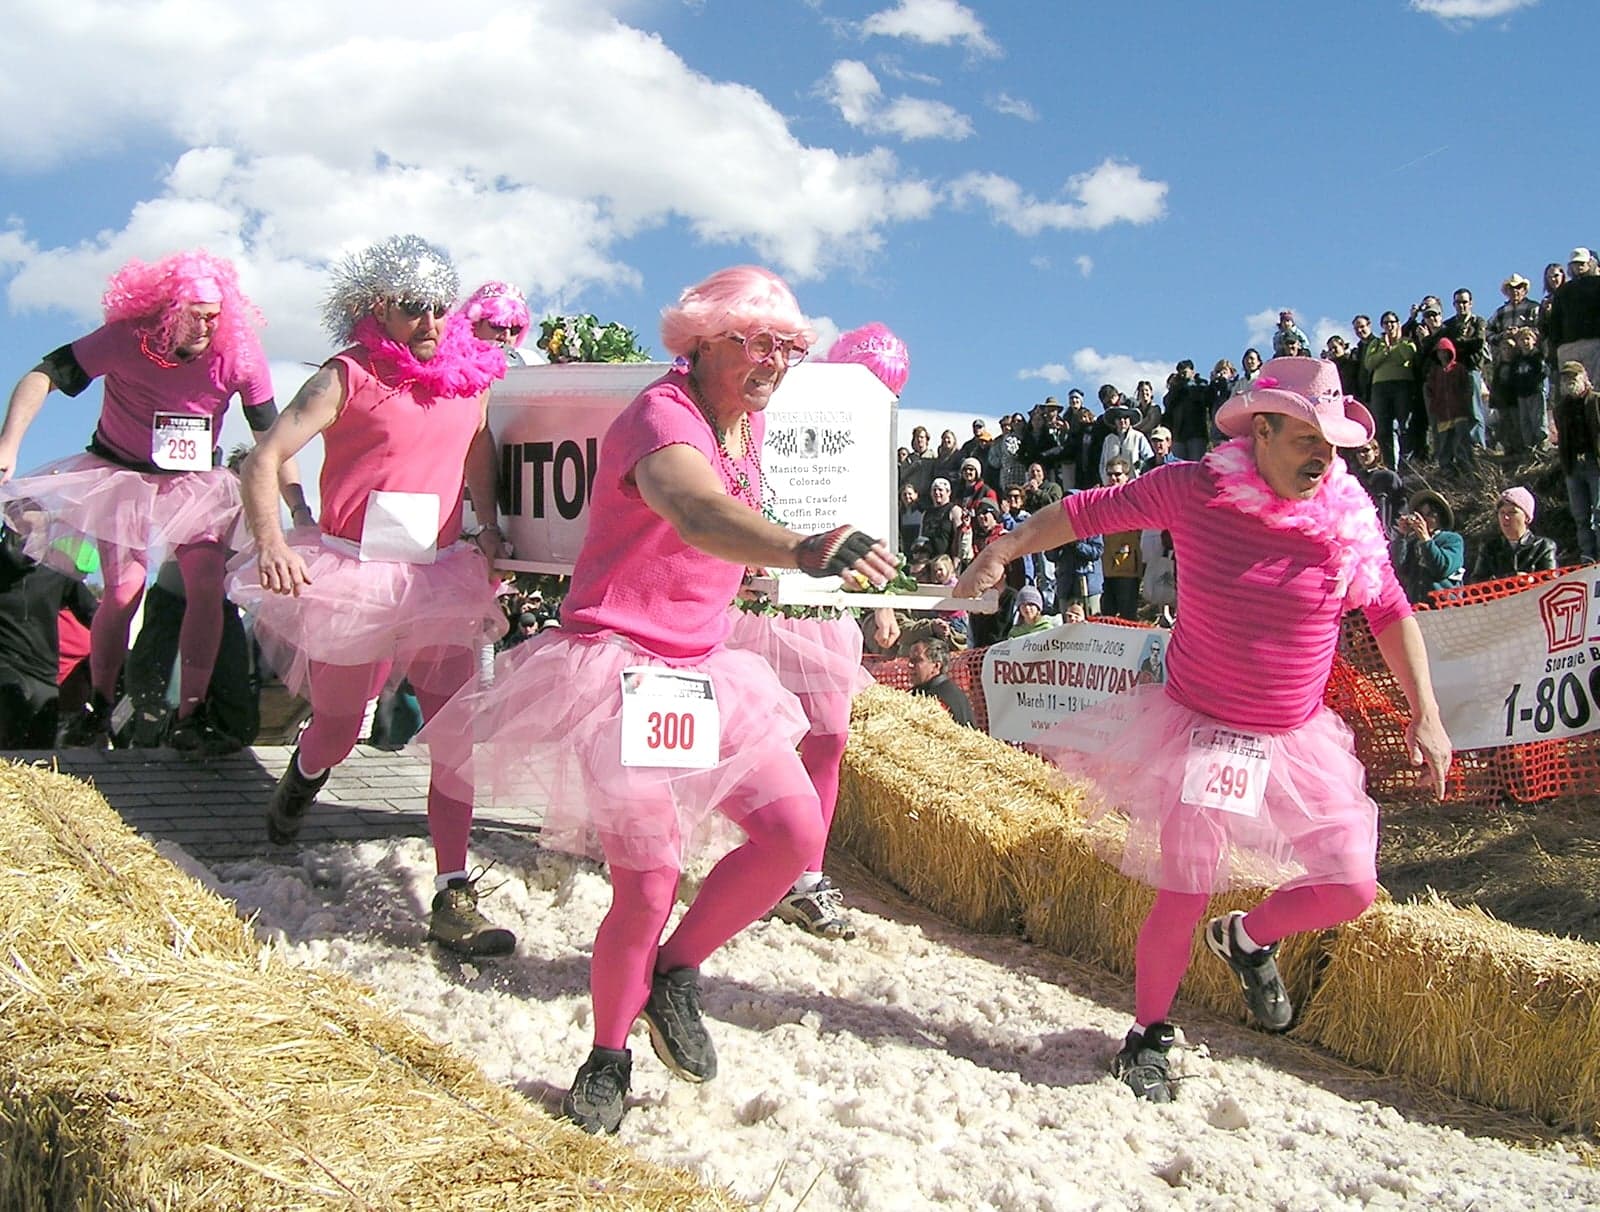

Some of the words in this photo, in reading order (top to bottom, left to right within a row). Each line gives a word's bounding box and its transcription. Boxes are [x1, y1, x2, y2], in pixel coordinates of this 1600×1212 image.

[168, 438, 197, 460] 293
[769, 464, 809, 474] Manitou
[789, 477, 831, 487] Colorado
[805, 494, 847, 504] Crawford
[783, 508, 812, 518] Coffin
[815, 507, 837, 517] Race
[791, 521, 836, 532] hampions
[1022, 639, 1050, 653] Proud
[1103, 640, 1125, 657] 2005
[994, 659, 1056, 686] FROZEN
[1086, 664, 1110, 692] GUY
[1017, 692, 1044, 709] March
[1048, 694, 1056, 710] 11
[1068, 696, 1077, 712] 13
[647, 711, 694, 750] 300
[1205, 763, 1249, 799] 299
